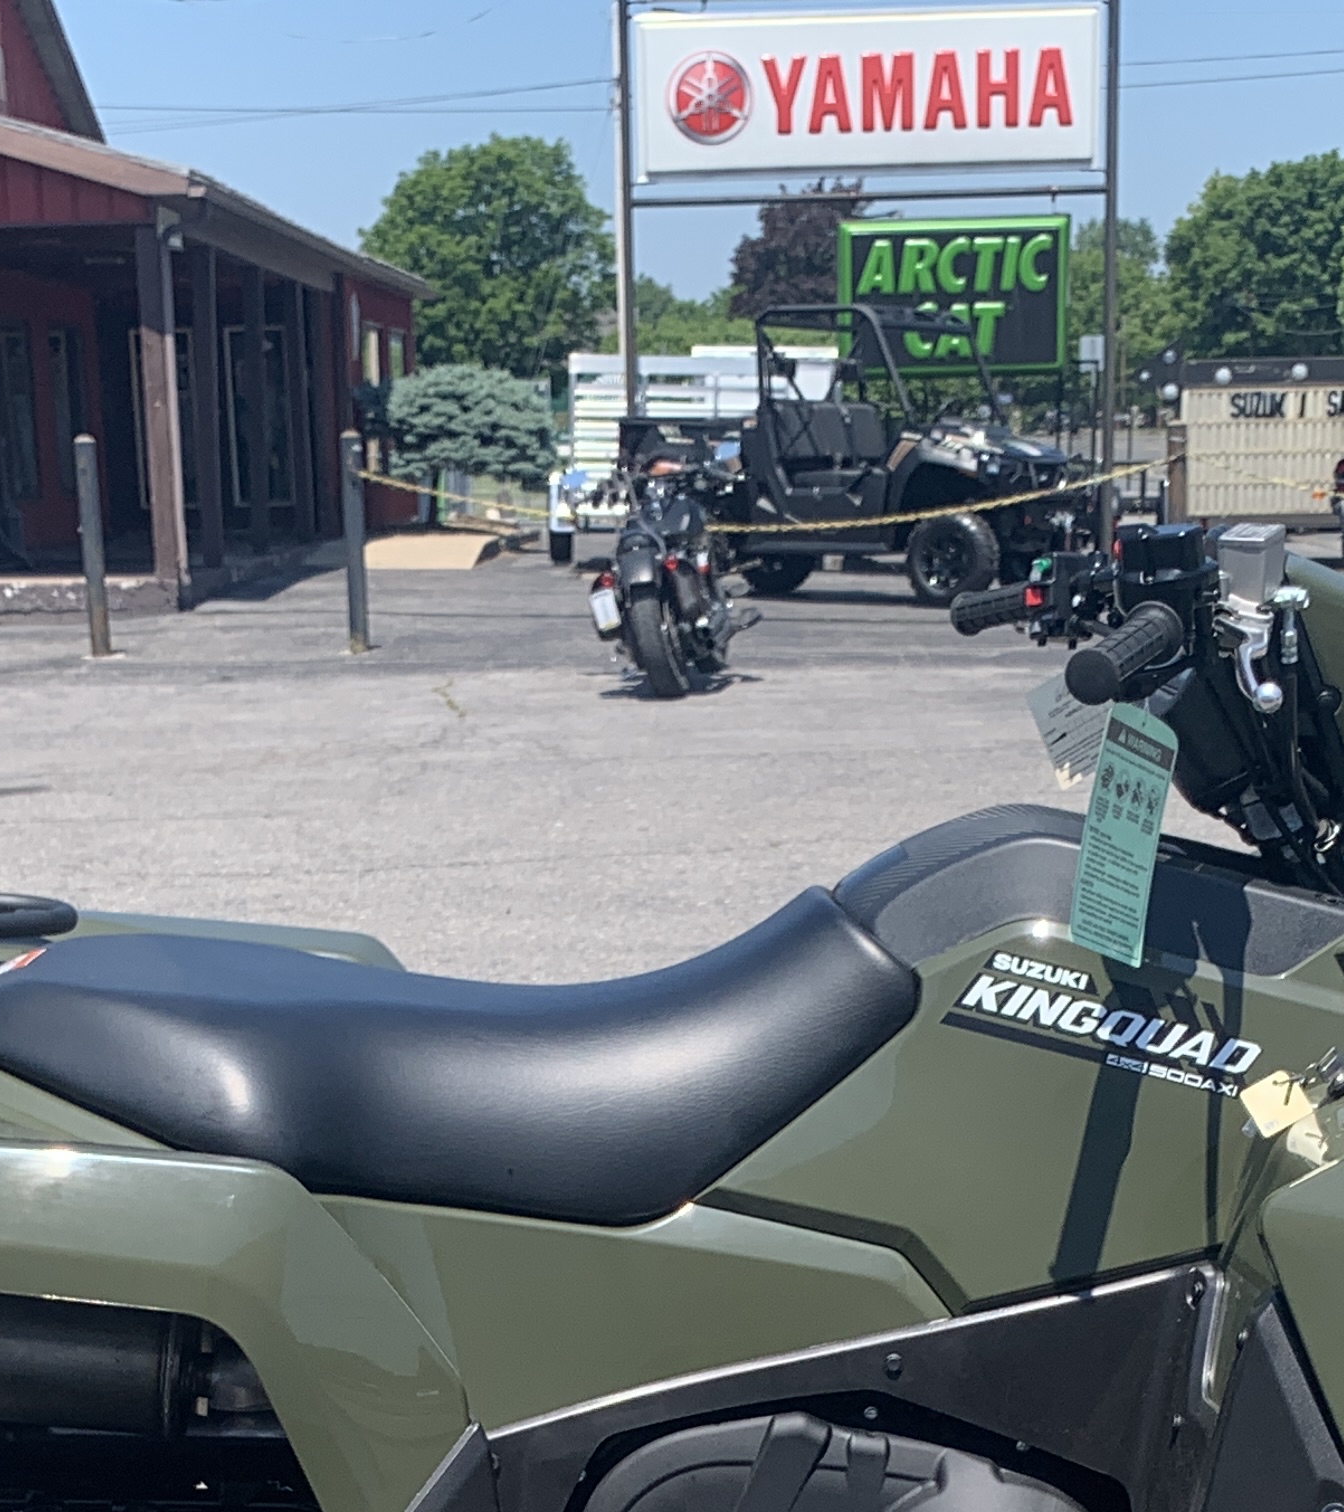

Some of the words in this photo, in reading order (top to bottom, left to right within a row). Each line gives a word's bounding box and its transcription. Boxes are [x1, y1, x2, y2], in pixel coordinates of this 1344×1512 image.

[761, 47, 1073, 135] YAMAHA
[856, 232, 1054, 295] ARCTIC
[992, 952, 1091, 991] SUZUKI
[961, 975, 1263, 1074] KINGQUAD
